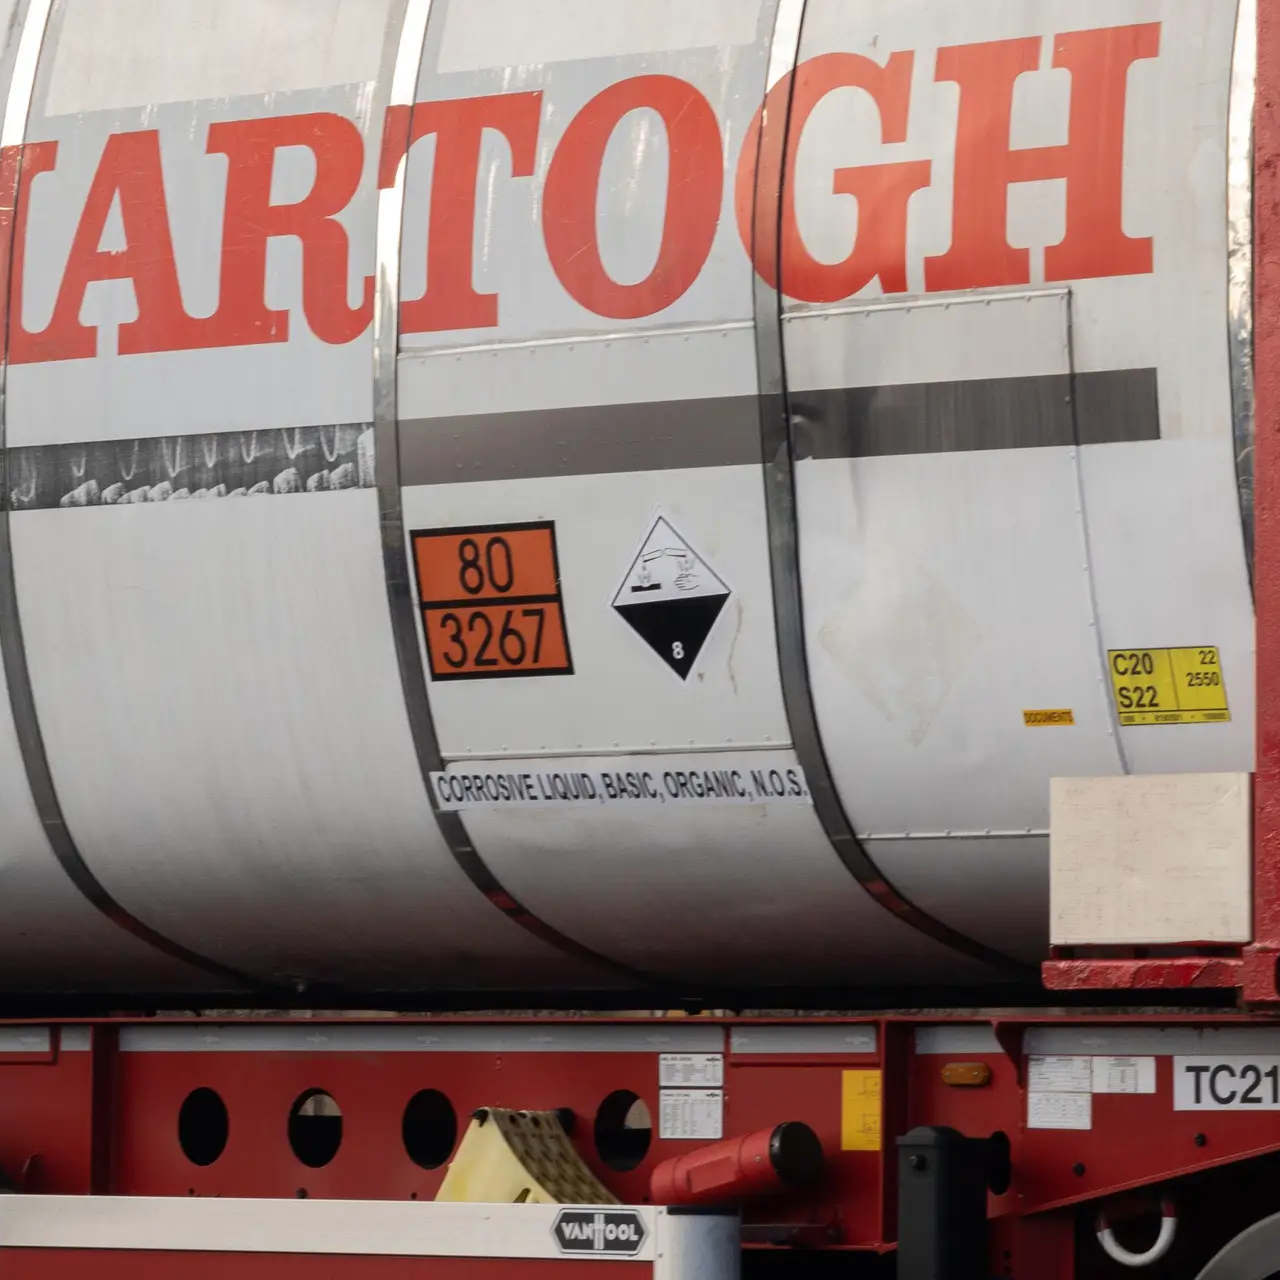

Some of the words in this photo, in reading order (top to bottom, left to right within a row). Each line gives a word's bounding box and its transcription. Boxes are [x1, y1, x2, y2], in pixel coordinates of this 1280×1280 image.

[458, 535, 515, 595] 80
[440, 608, 545, 669] 3267
[672, 642, 685, 659] 8
[1198, 650, 1217, 665] 22
[1113, 653, 1154, 676] C20
[1186, 672, 1220, 688] 2550
[1118, 686, 1160, 709] S22
[437, 774, 538, 802] CORROSIVE
[537, 773, 605, 804] LIQUID,
[601, 771, 666, 804] BASIC,
[663, 770, 755, 802] ORGANIC,
[750, 769, 809, 797] N.O.S.
